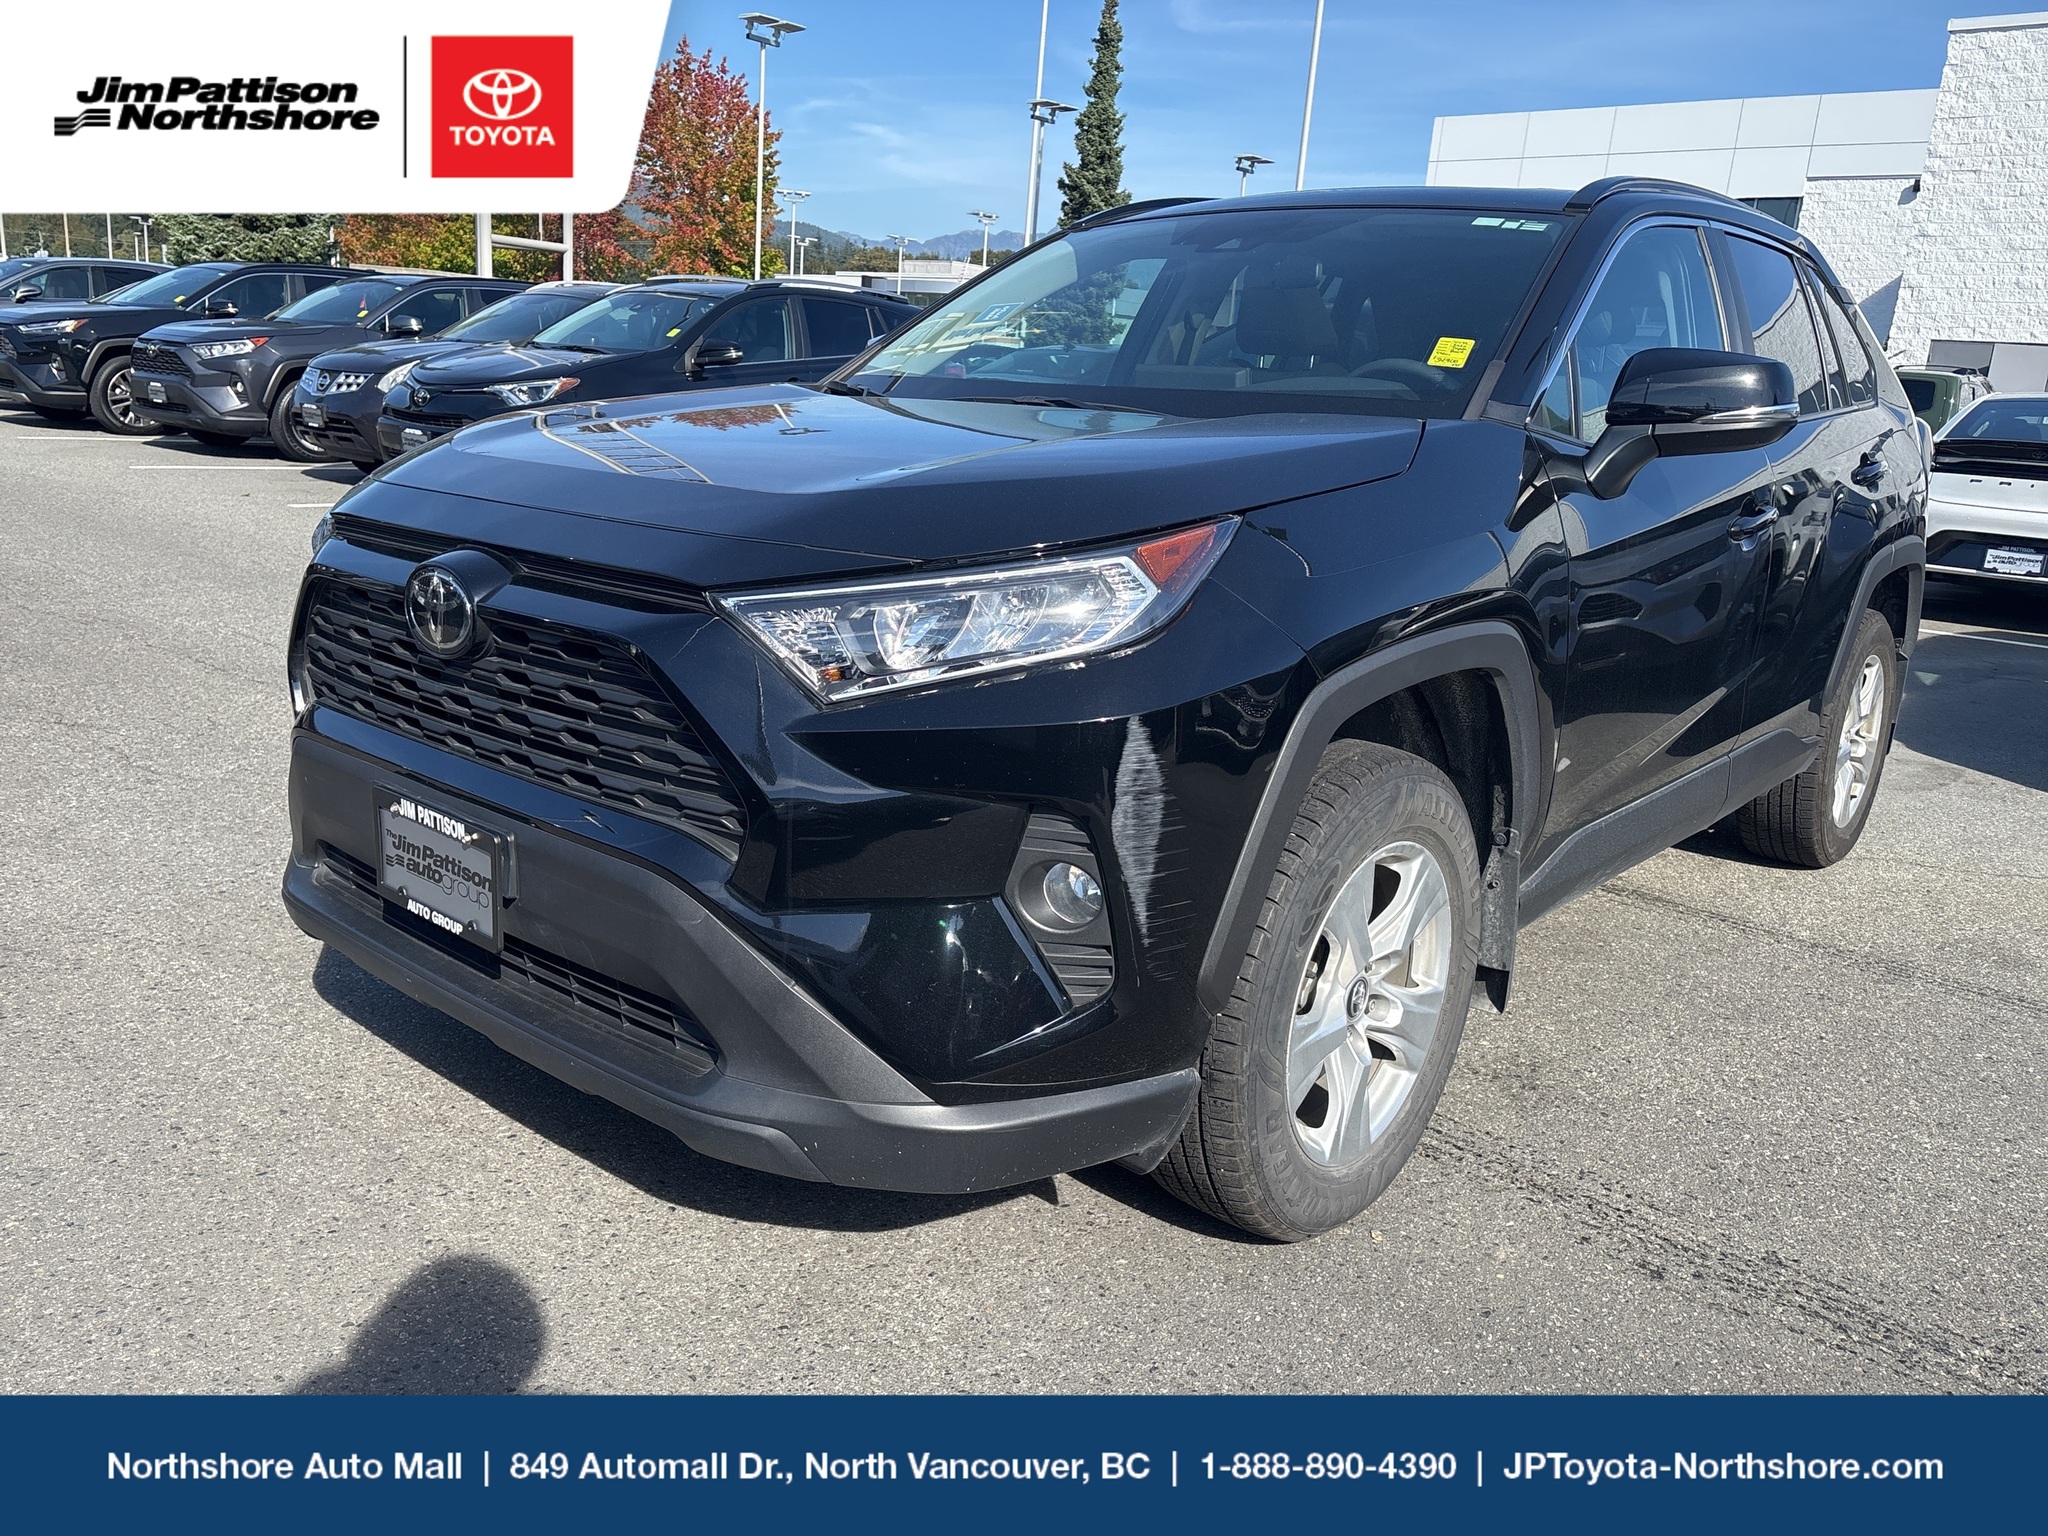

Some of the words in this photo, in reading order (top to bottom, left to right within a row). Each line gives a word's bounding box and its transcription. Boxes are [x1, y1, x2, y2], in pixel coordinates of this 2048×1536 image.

[385, 828, 398, 840] The
[399, 798, 416, 822] JIM
[417, 803, 466, 840] PATTISON
[406, 856, 490, 911] autogroup
[406, 898, 431, 921] AUTO
[431, 909, 464, 936] GROUP
